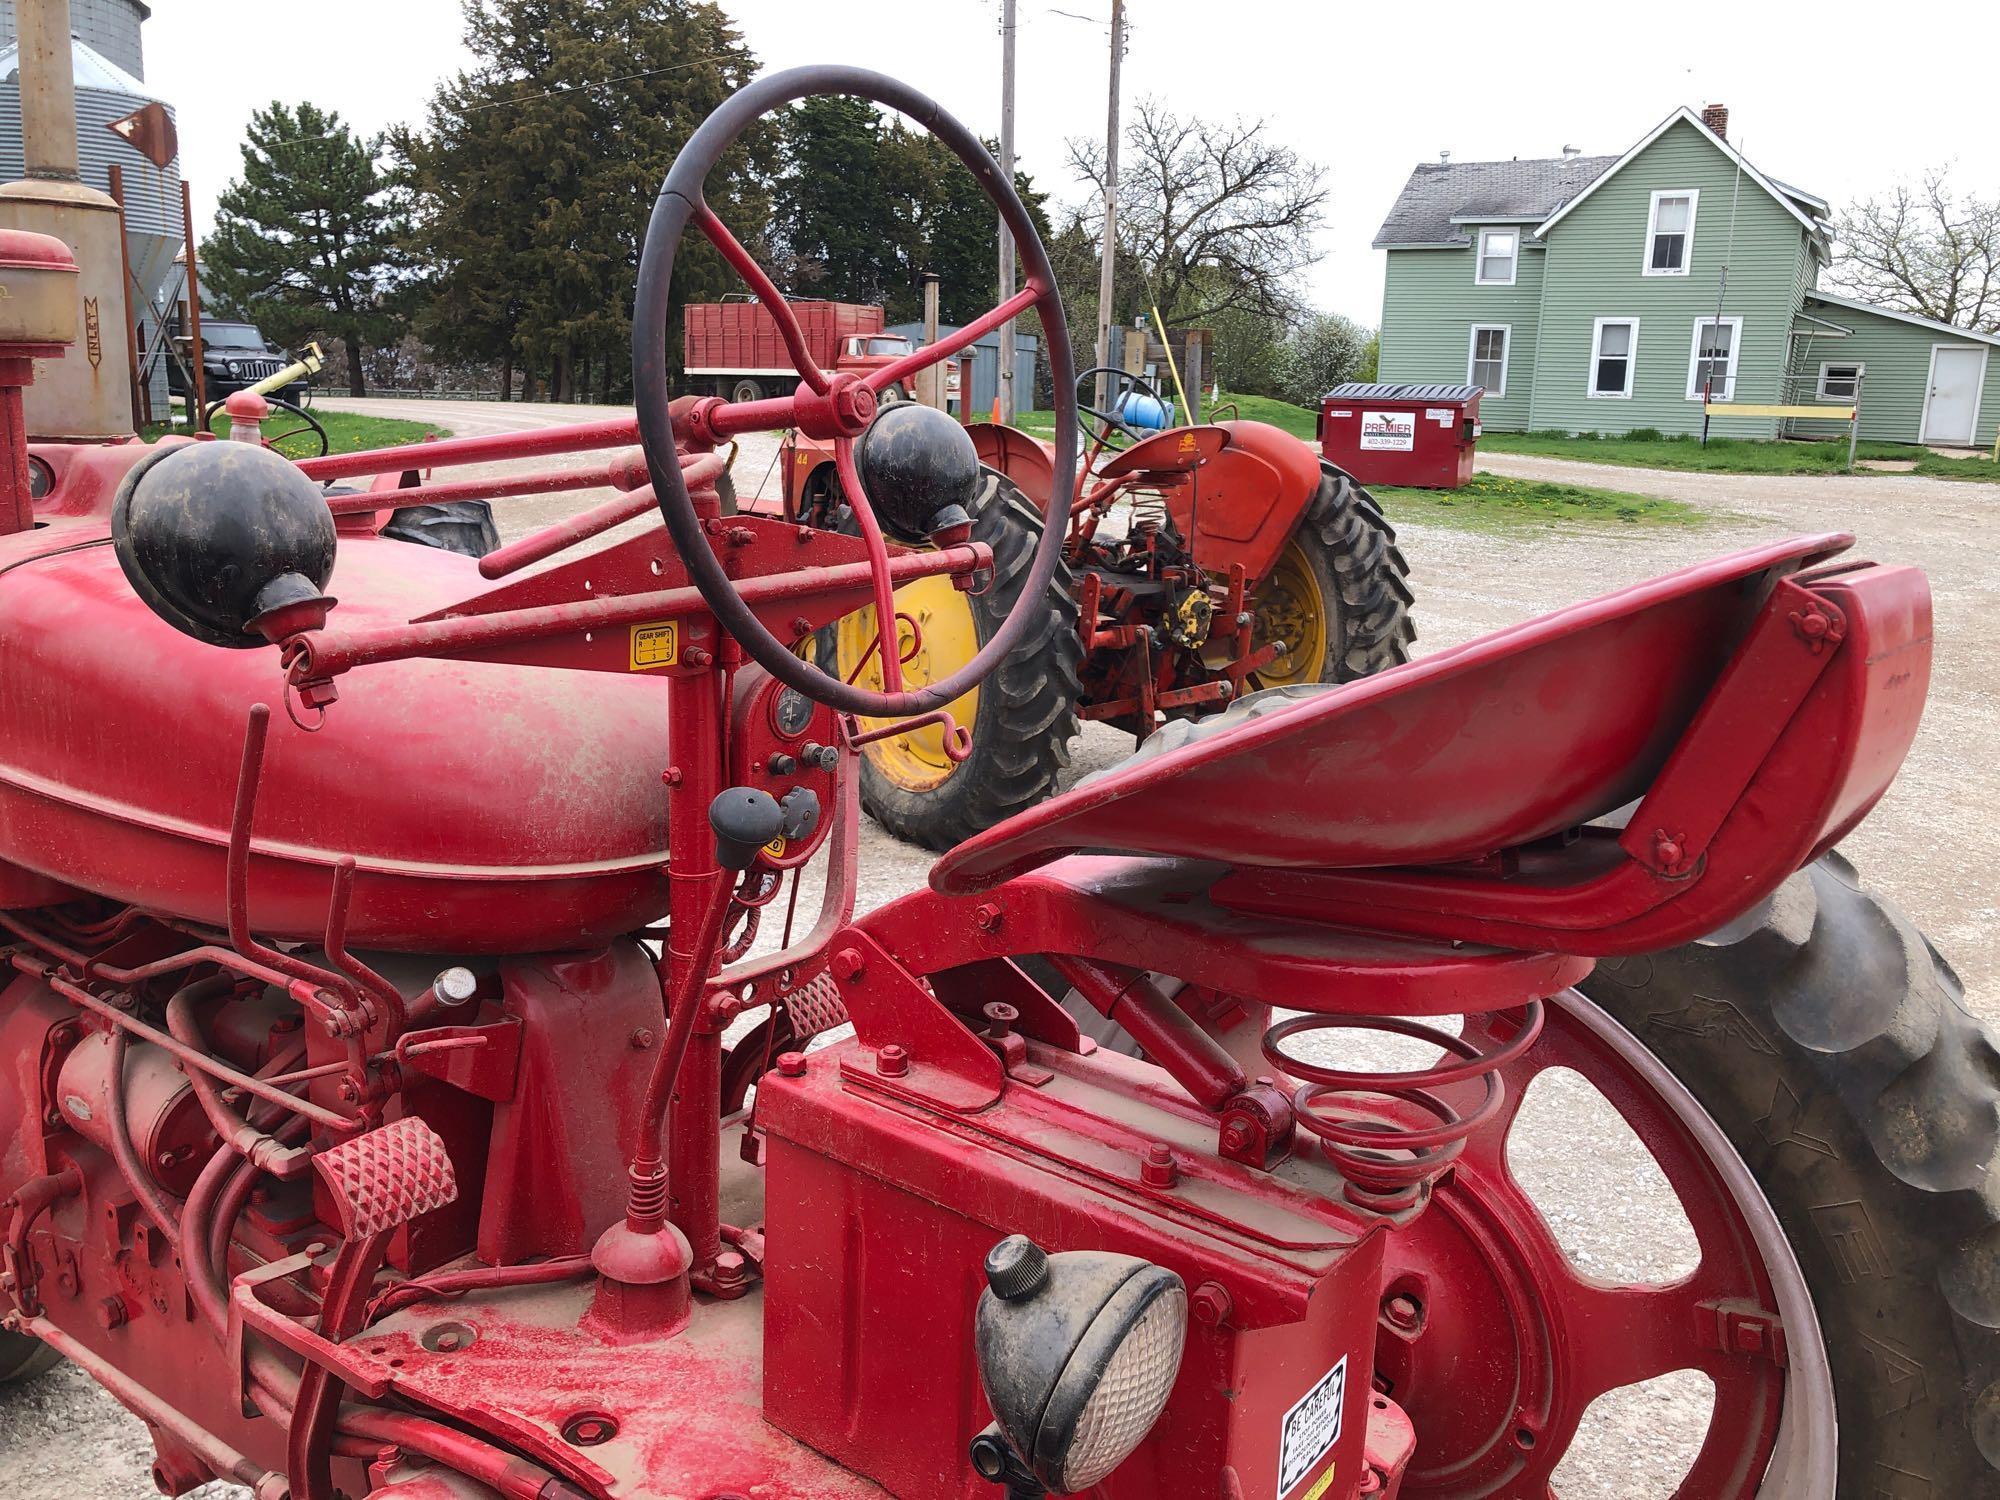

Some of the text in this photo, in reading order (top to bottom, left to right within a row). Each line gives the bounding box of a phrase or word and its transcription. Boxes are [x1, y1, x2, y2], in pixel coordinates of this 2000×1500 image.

[87, 312, 99, 357] INLET
[1365, 423, 1411, 433] PREMIER
[797, 453, 808, 465] 44
[1291, 1381, 1335, 1438] BE CAREFUL
